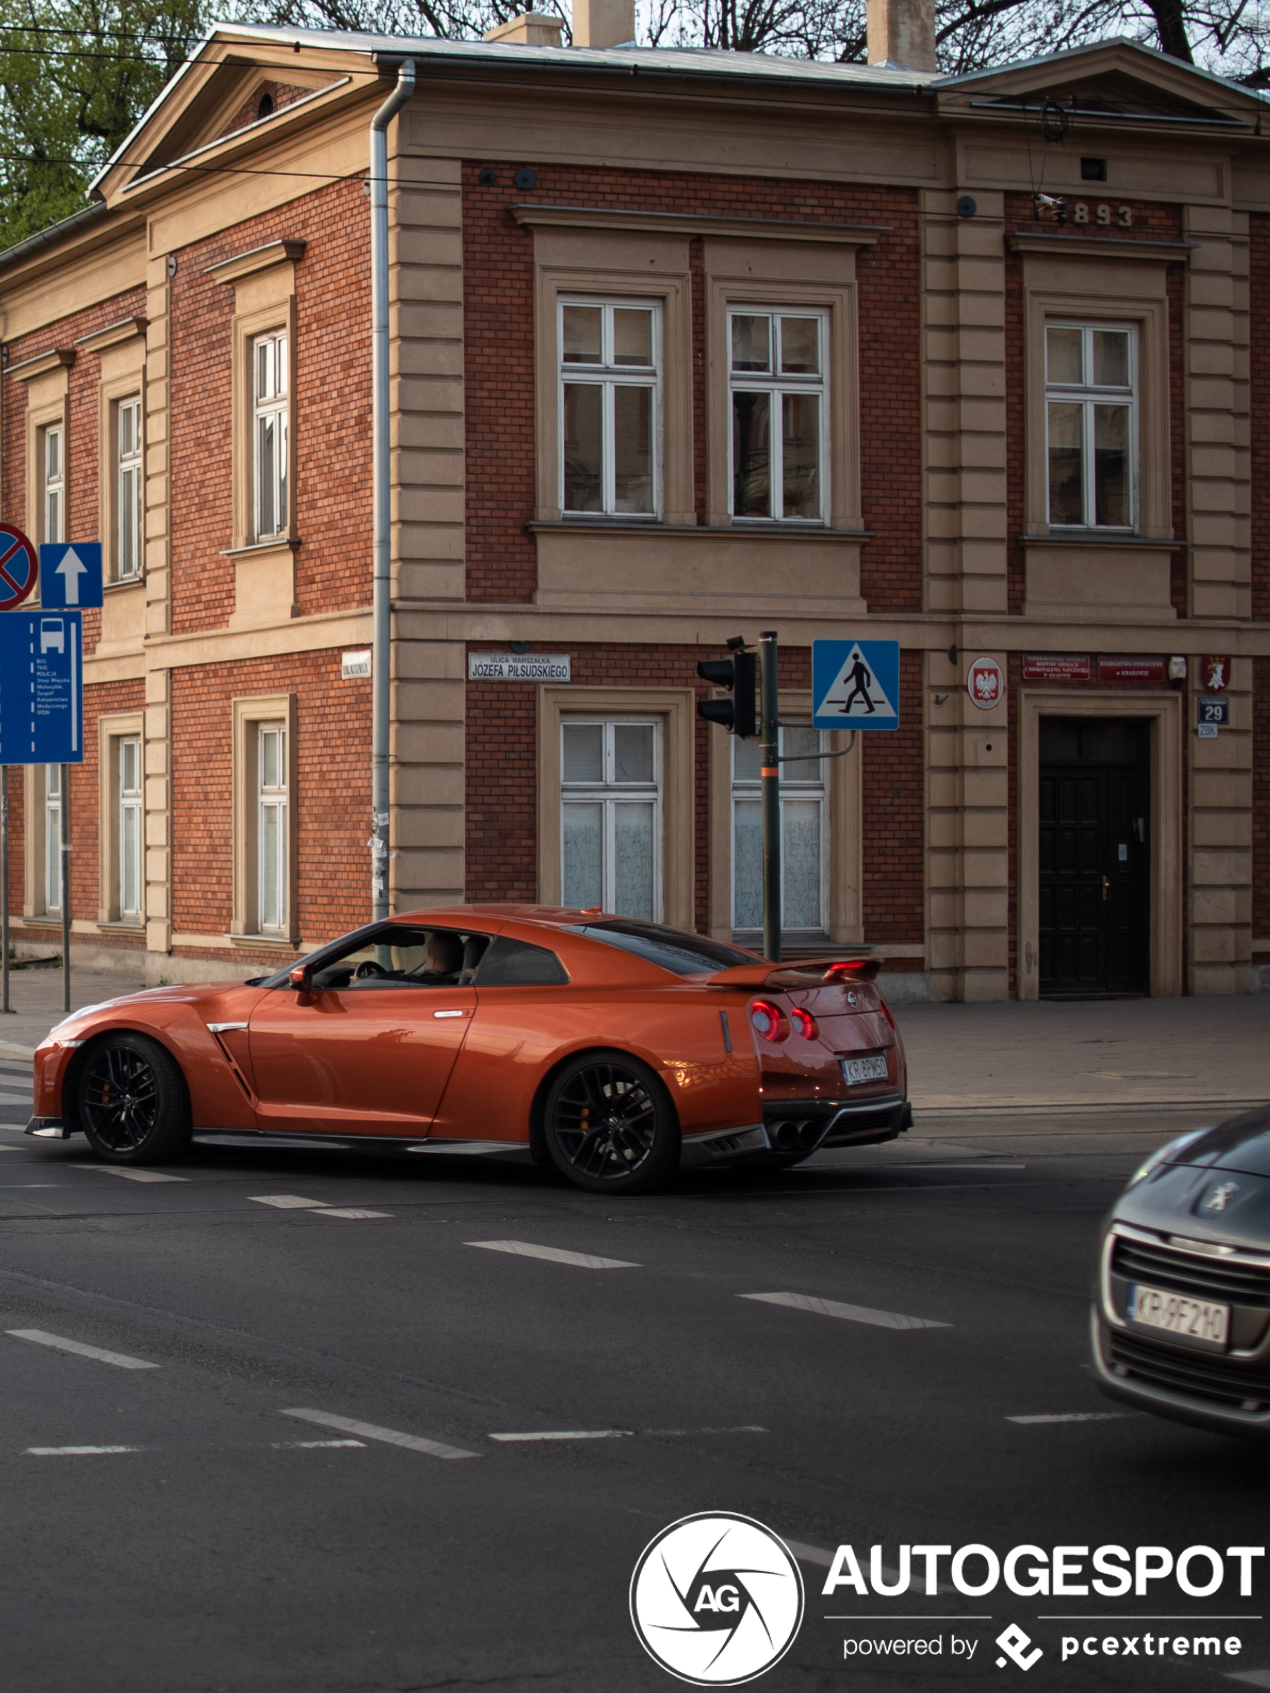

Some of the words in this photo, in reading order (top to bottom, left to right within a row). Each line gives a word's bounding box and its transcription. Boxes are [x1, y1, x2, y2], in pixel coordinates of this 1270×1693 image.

[1073, 203, 1132, 227] 893
[473, 662, 504, 677] JÓZEFA
[508, 665, 567, 677] PIŁSUDSKIEGO
[1205, 706, 1223, 721] 29
[1200, 725, 1216, 736] ZBK
[847, 1061, 861, 1080] KR
[1138, 1289, 1163, 1322] KR
